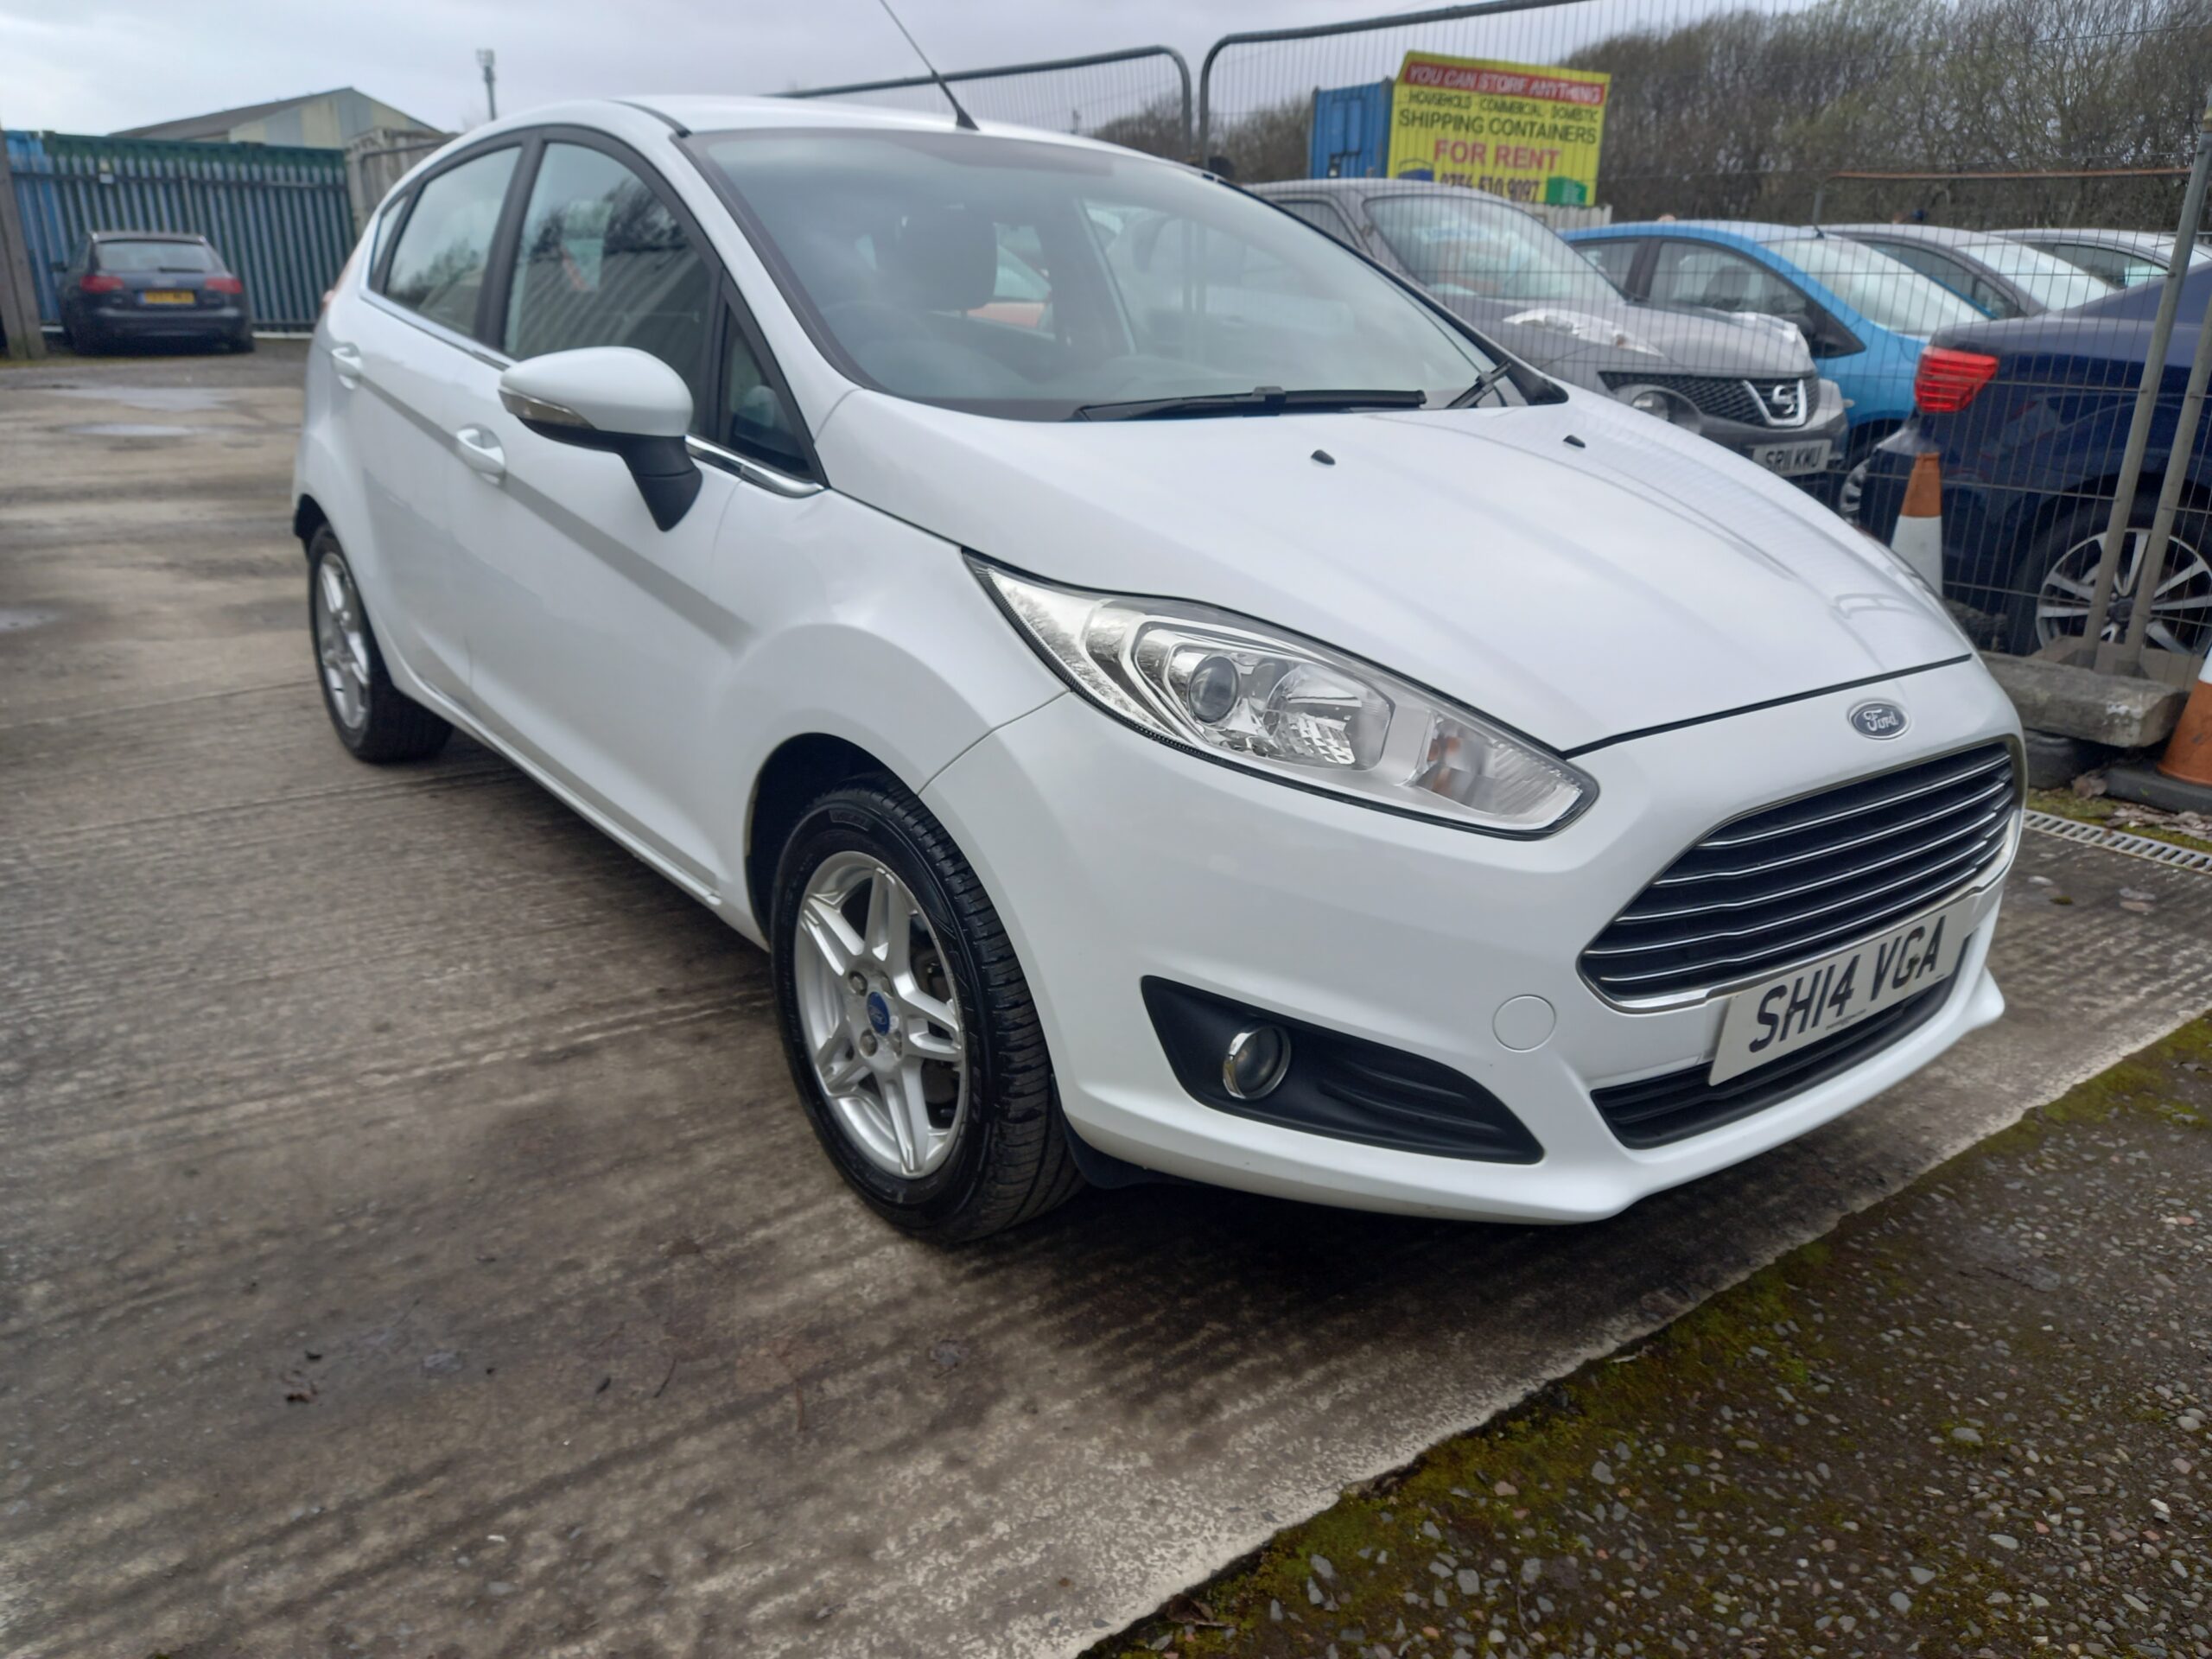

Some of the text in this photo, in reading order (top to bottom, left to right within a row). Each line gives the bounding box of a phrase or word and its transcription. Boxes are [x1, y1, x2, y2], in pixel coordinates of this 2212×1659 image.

[1409, 65, 1601, 104] YOU CAN STORE ANYTHING
[1399, 109, 1597, 144] SHIPPING CONTAINERS
[1433, 138, 1560, 171] FOR RENT
[1863, 709, 1899, 732] Ford
[1749, 916, 1946, 1052] SH14 VGA
